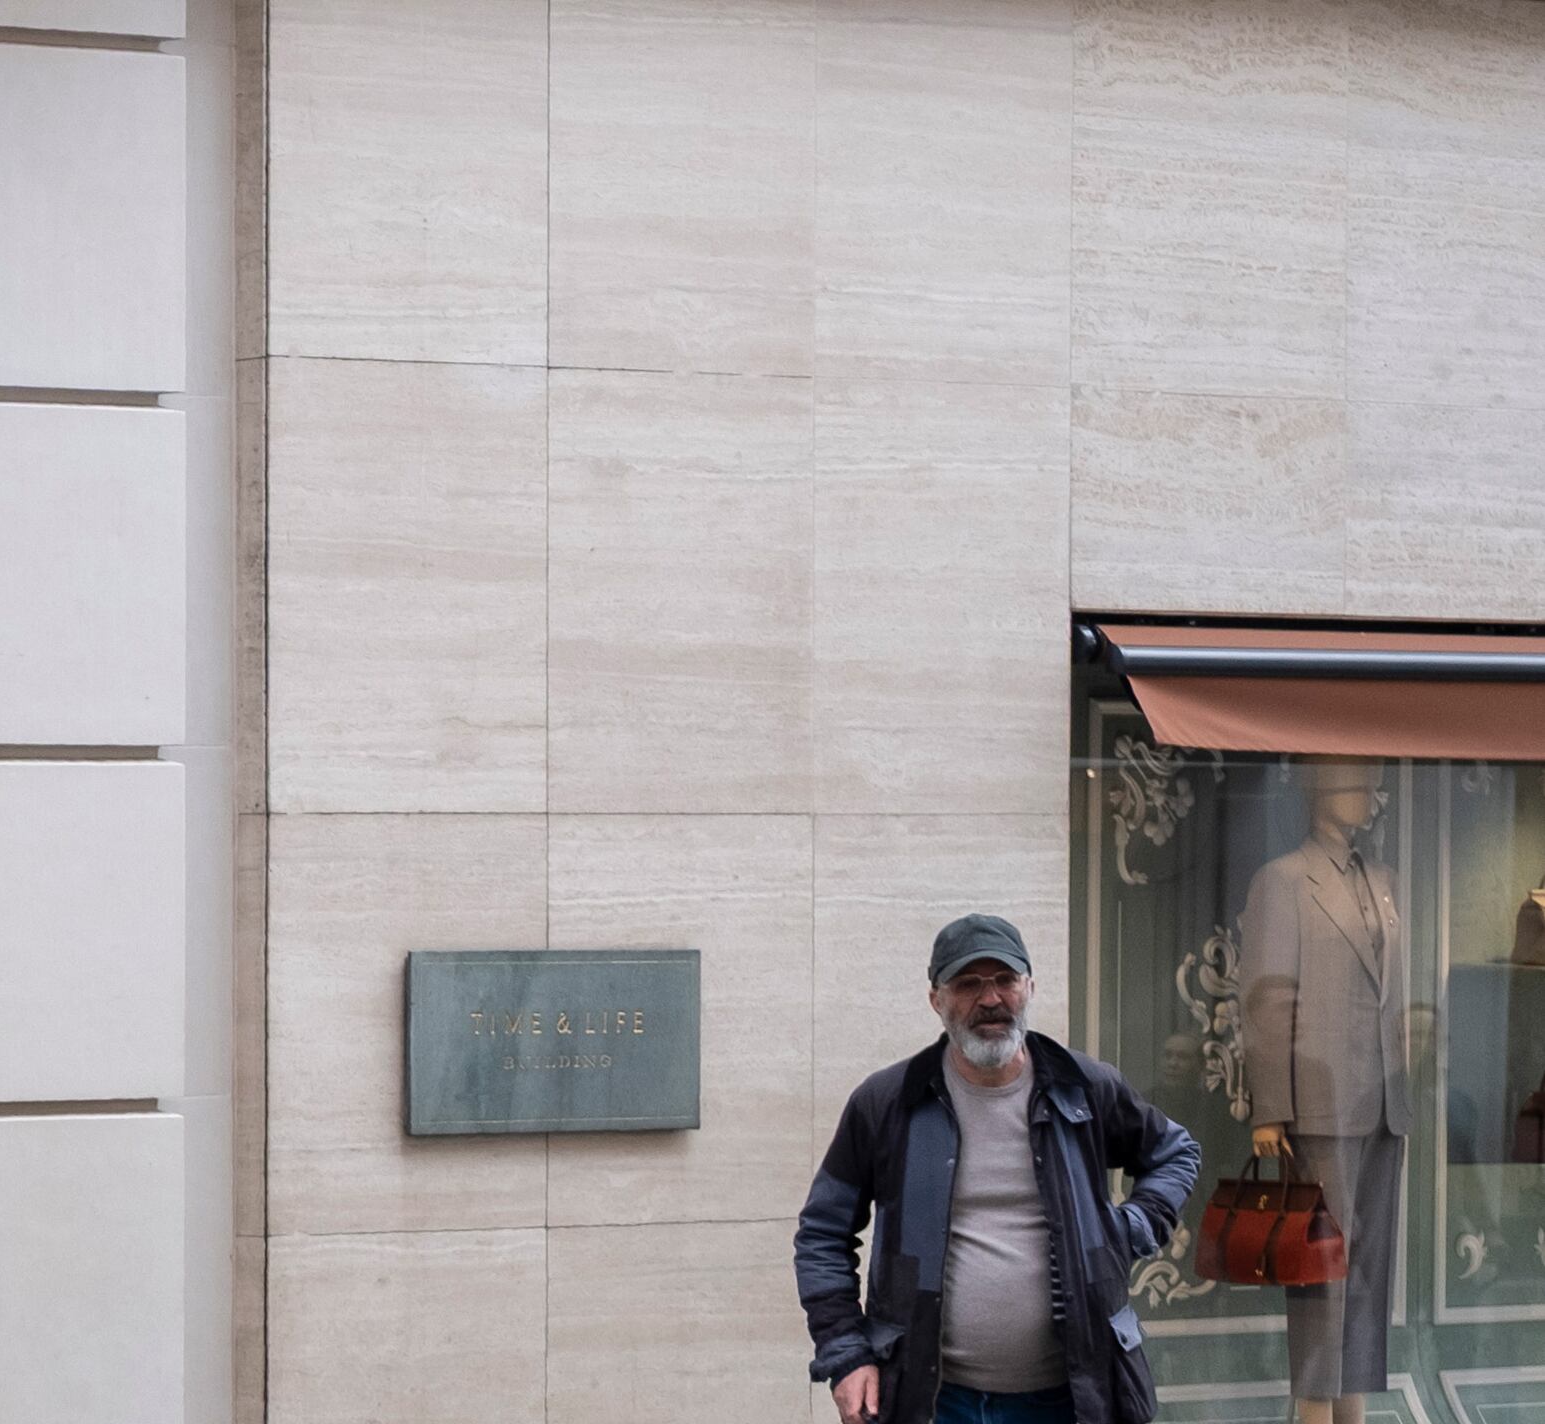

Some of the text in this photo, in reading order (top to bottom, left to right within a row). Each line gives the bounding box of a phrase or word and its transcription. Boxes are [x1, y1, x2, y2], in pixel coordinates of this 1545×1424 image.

[470, 1011, 645, 1035] TIME & LIFE
[502, 1054, 612, 1071] BUILDING
